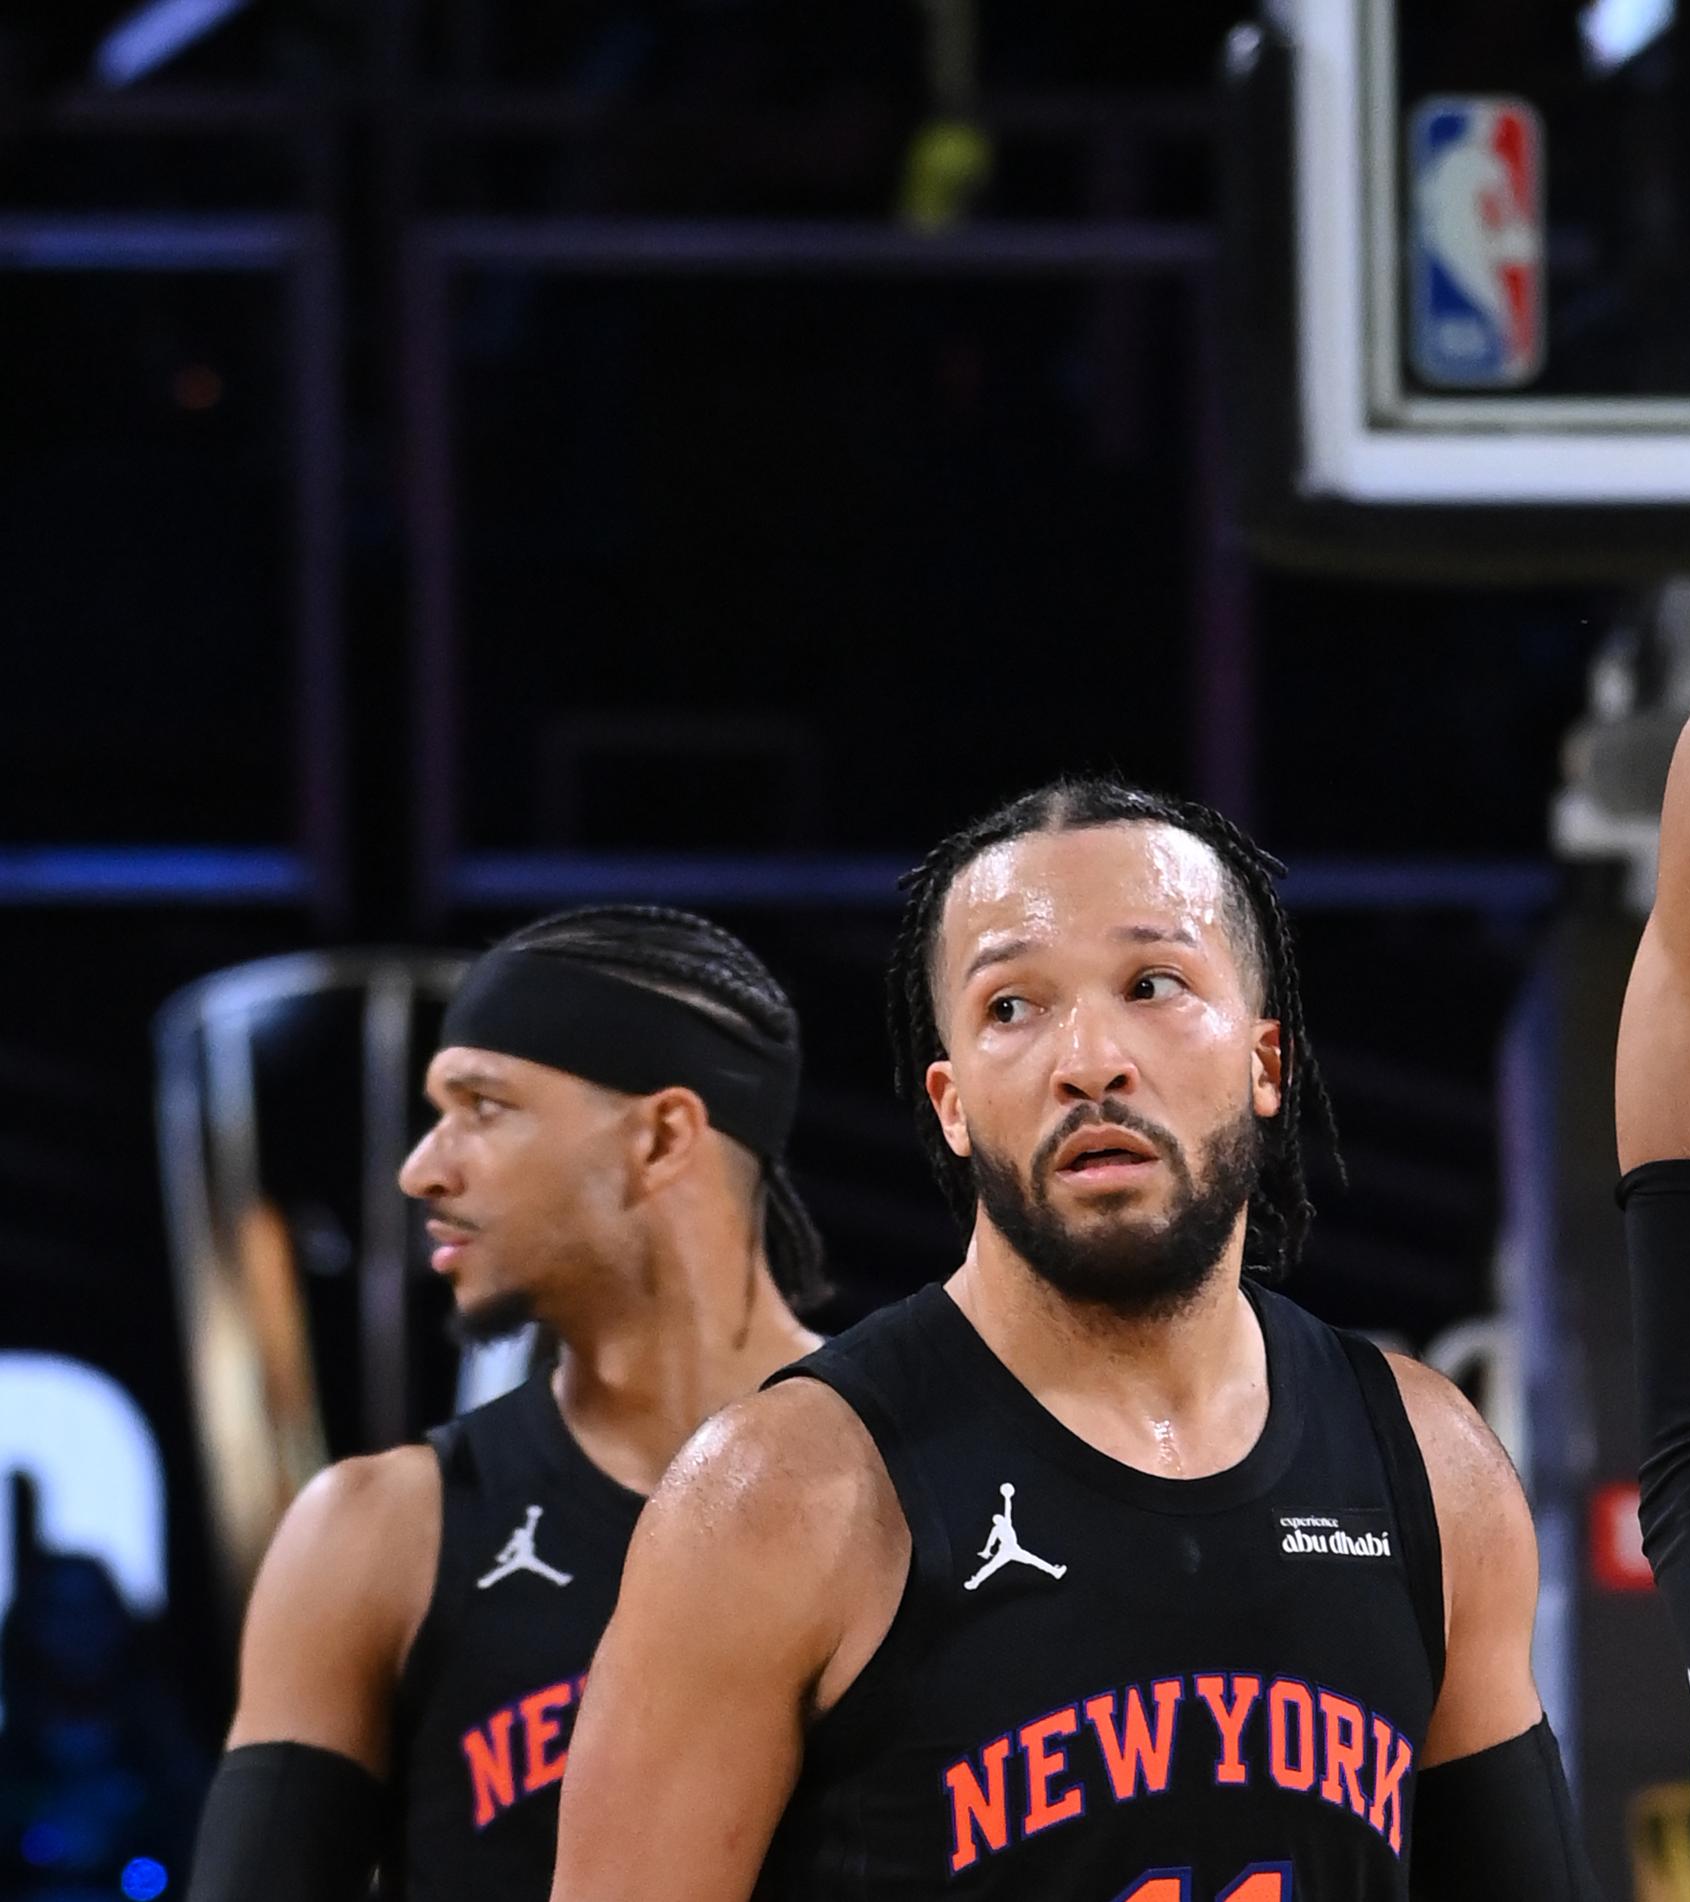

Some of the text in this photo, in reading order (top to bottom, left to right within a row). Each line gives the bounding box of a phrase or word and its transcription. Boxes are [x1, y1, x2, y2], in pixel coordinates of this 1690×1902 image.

[1280, 1515, 1339, 1529] experience
[1282, 1529, 1391, 1556] abu dhabi
[463, 1670, 588, 1828] NE
[942, 1671, 1414, 1877] NEW YORK
